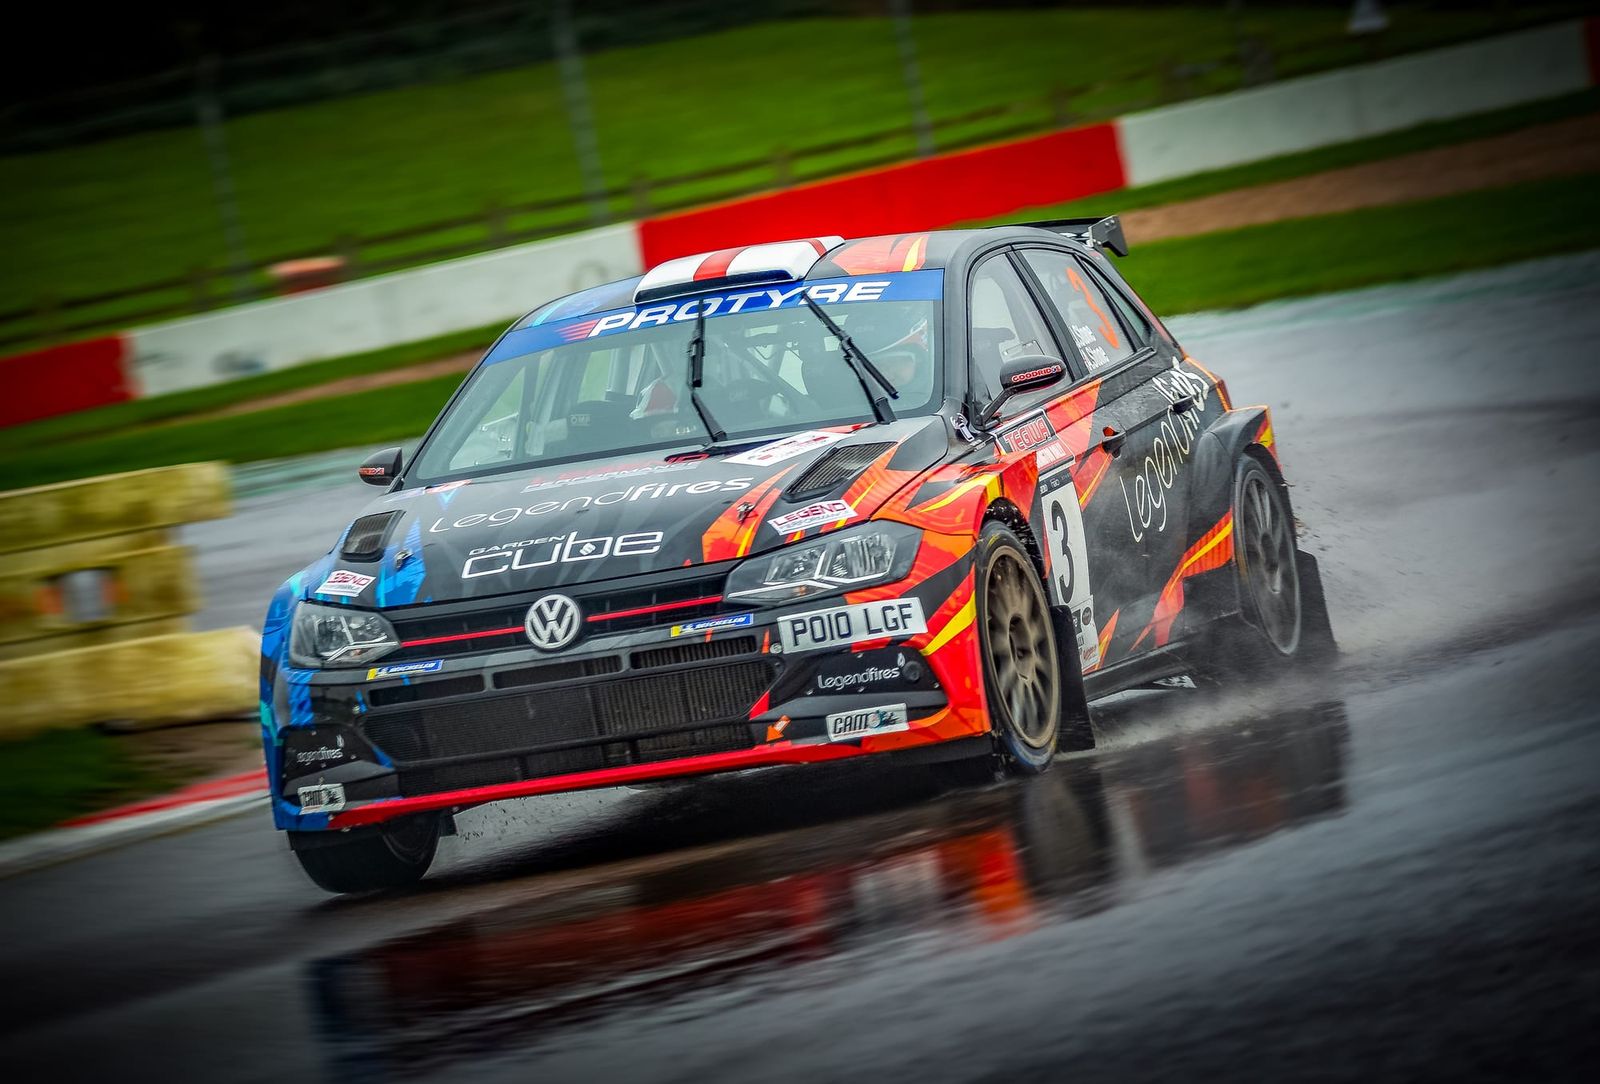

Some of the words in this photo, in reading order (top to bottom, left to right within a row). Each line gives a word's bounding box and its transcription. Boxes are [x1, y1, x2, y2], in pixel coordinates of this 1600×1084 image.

[588, 281, 891, 338] PROTYRE
[1065, 267, 1120, 350] 3
[773, 502, 847, 526] LEGEND
[469, 535, 566, 556] GARDEN
[1051, 500, 1075, 604] 3
[527, 595, 578, 647] VW
[790, 611, 852, 647] PO10
[864, 603, 913, 635] LGF
